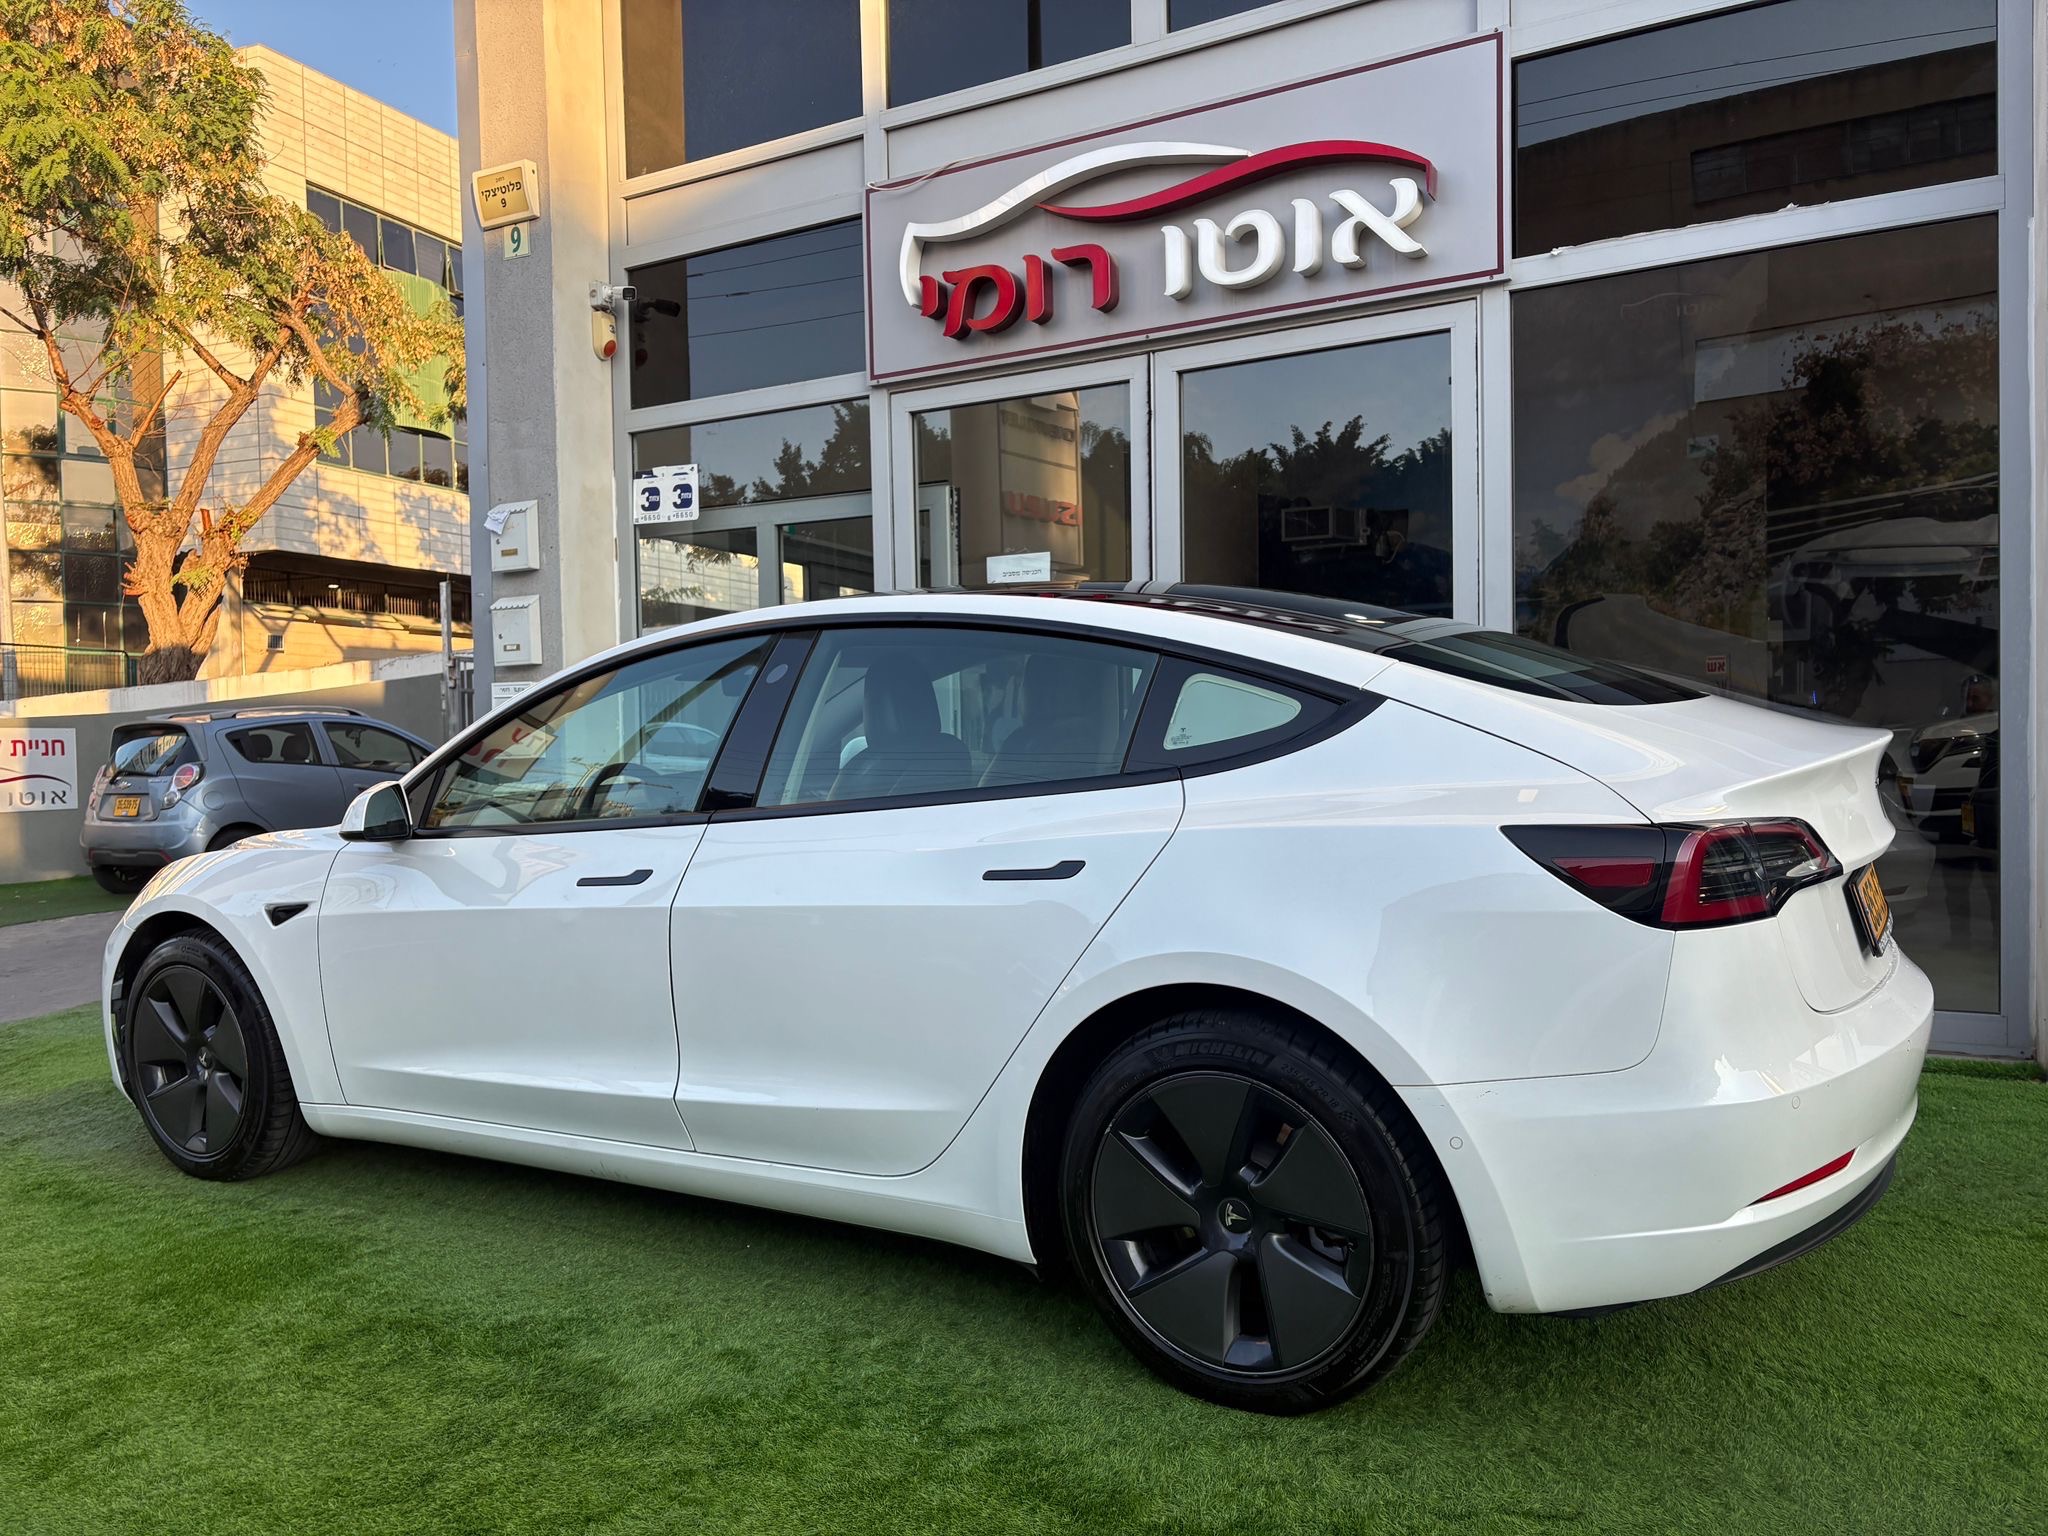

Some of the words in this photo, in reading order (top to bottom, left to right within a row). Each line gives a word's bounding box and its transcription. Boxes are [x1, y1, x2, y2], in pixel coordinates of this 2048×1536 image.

[481, 181, 522, 202] פלוטיצקי
[500, 198, 507, 208] 9
[510, 226, 521, 253] 9
[1161, 177, 1429, 301] אוטו
[920, 243, 1120, 340] רומי
[1707, 661, 1725, 673] אש
[10, 739, 65, 757] חניית
[8, 790, 67, 807] אוטו
[1174, 1039, 1269, 1065] MICHELIN
